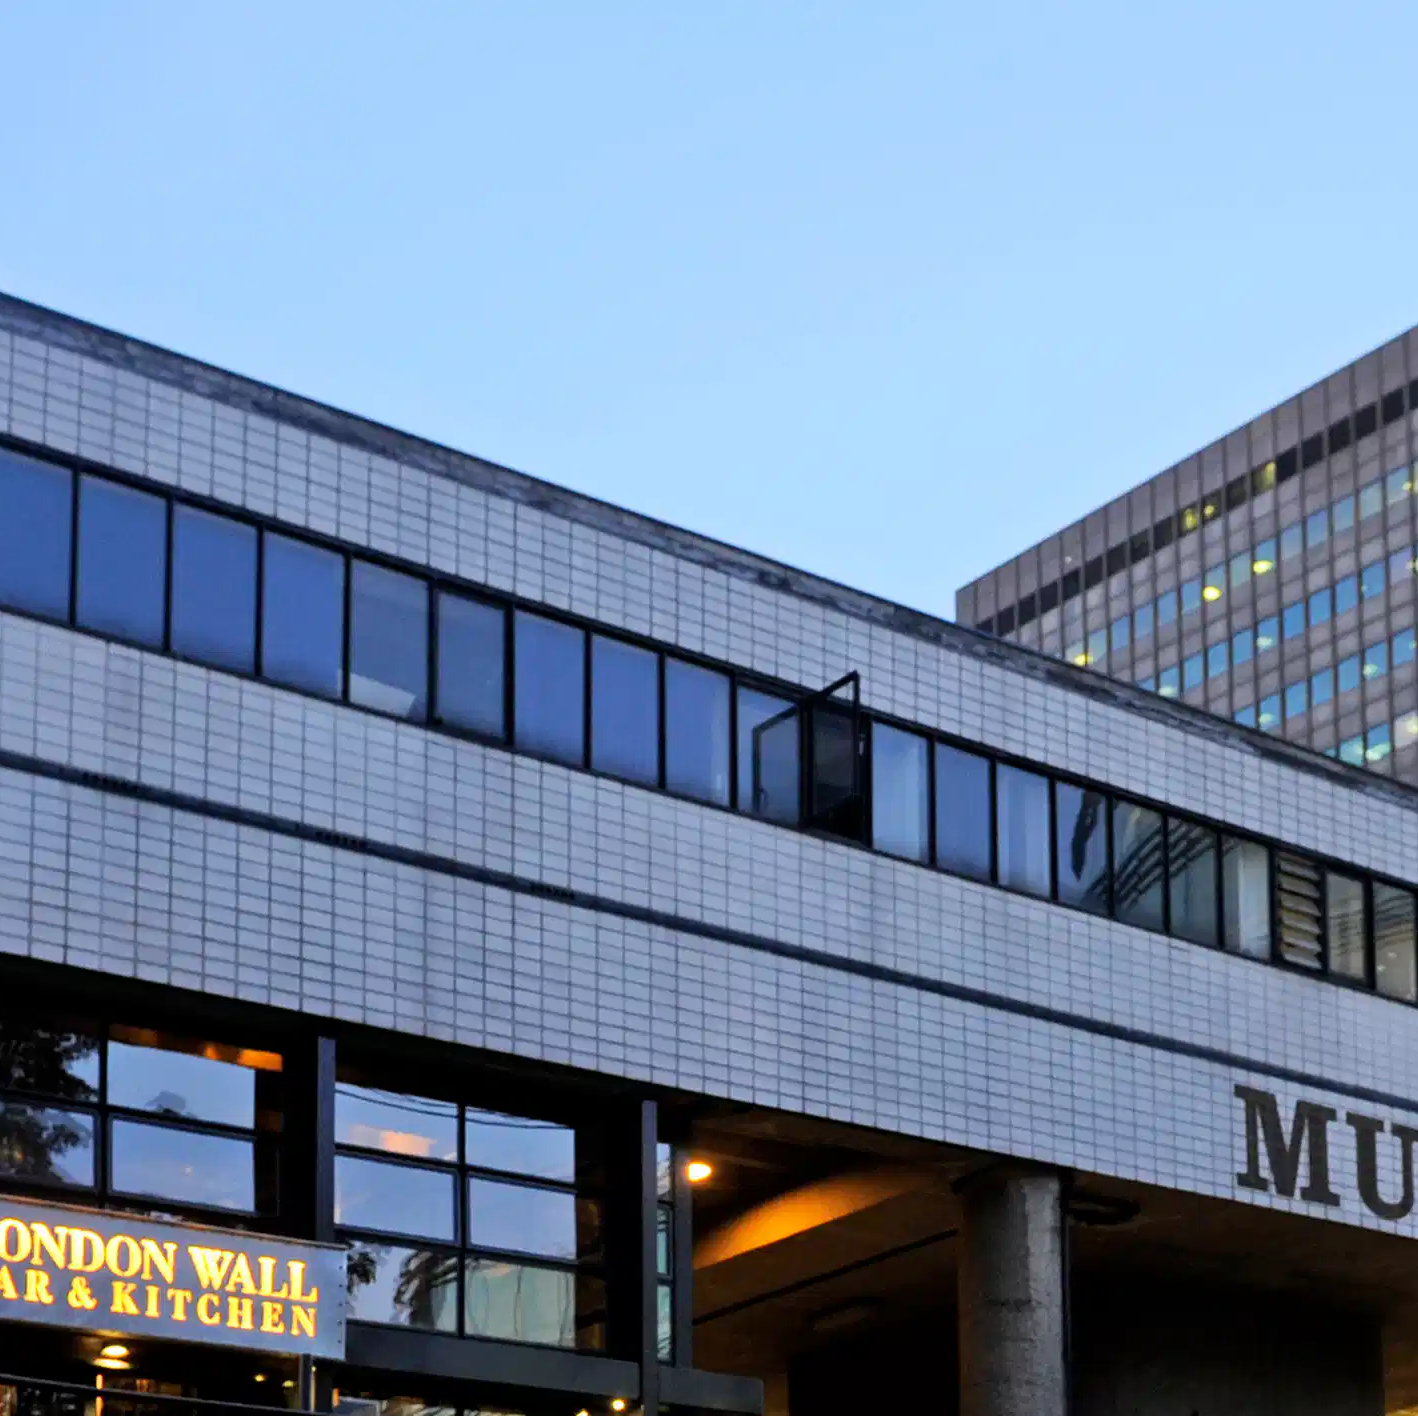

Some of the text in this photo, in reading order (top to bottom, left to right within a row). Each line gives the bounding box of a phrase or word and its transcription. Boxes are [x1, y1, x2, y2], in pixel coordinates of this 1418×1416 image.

[188, 1246, 318, 1302] WALL
[67, 1275, 98, 1310] &
[110, 1280, 317, 1338] KITCHEN
